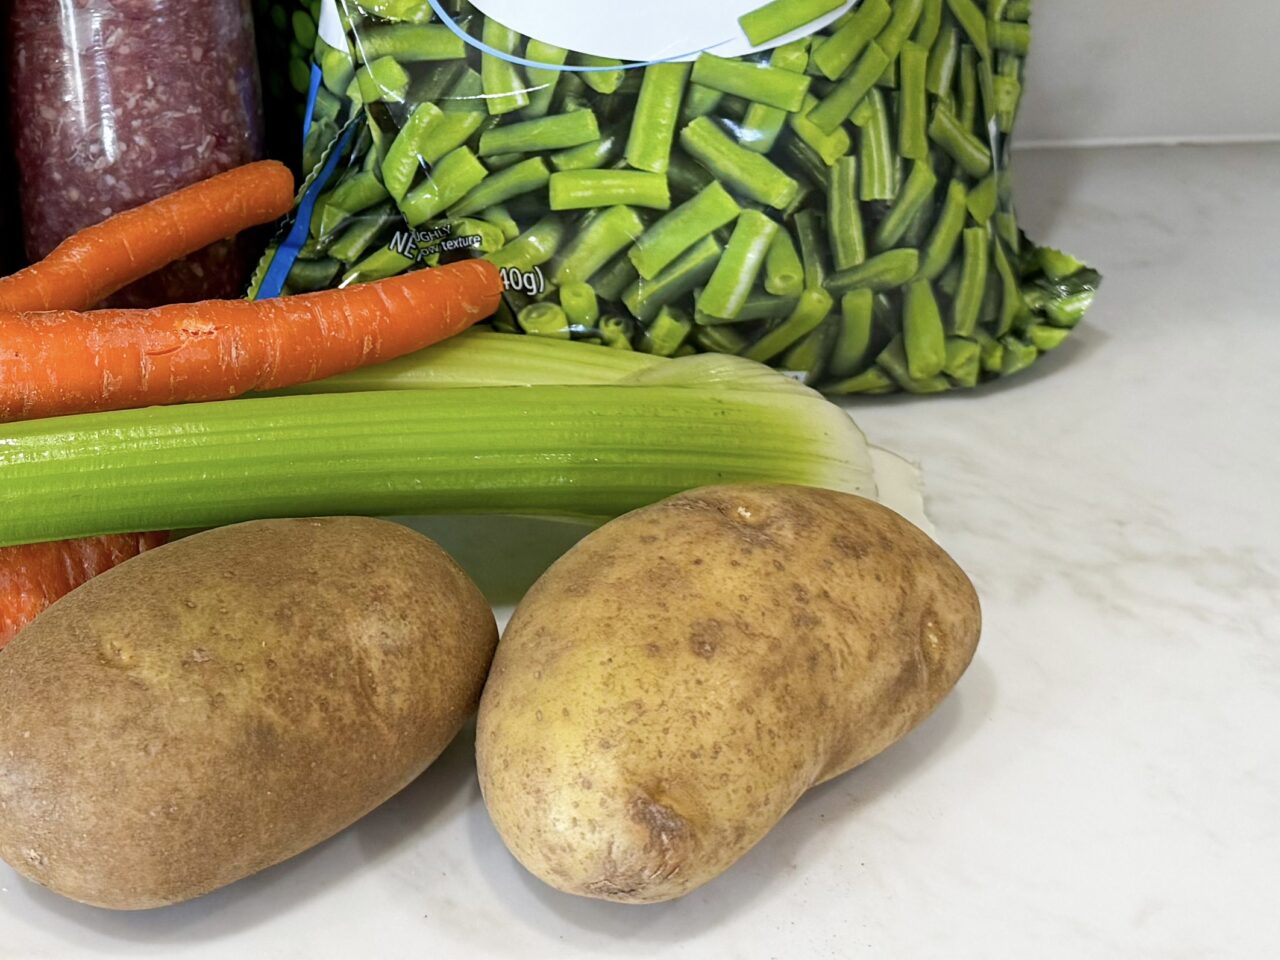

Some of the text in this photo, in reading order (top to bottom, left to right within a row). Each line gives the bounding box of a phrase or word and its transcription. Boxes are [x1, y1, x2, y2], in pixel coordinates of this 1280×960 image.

[412, 224, 451, 242] UGHLY
[441, 235, 481, 251] texture
[389, 231, 545, 296] NE 40g)
